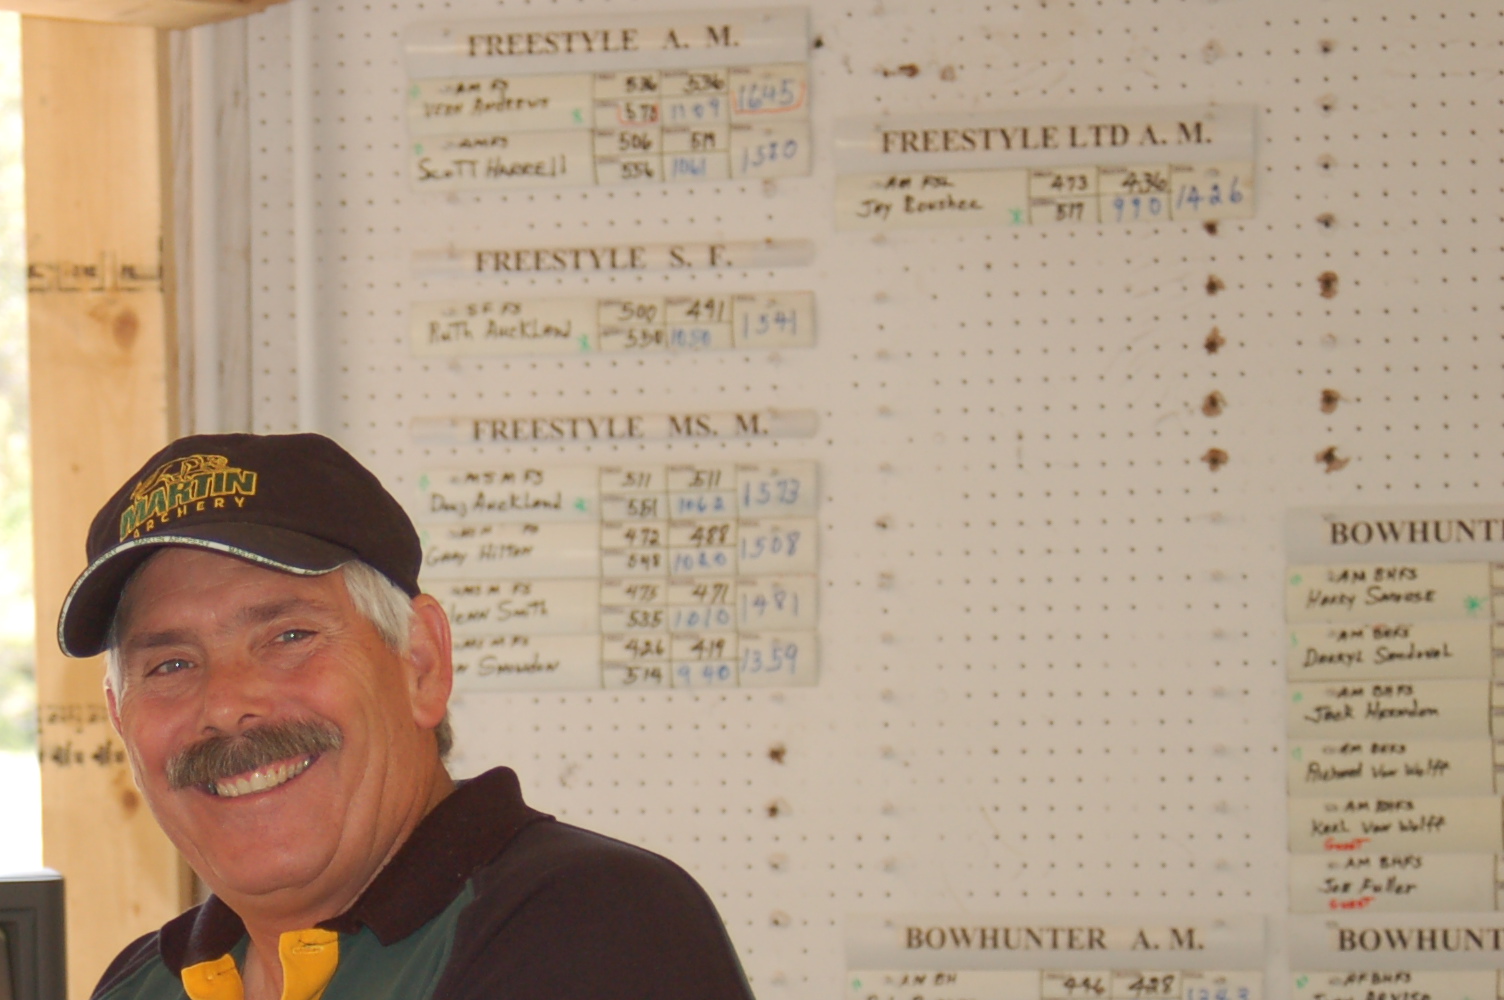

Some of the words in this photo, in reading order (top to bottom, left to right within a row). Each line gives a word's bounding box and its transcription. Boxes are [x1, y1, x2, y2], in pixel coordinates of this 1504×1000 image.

[467, 29, 639, 57] FREESTYLE
[663, 27, 690, 50] A.
[707, 24, 740, 48] M.
[739, 78, 797, 112] 1645
[882, 125, 1059, 154] FREESTYLE
[1070, 123, 1130, 149] LTD
[1139, 124, 1167, 147] A.
[1177, 120, 1212, 145] M.
[1113, 195, 1162, 222] 990
[1177, 175, 1244, 212] 1426
[475, 246, 648, 272] FREESTYLE
[670, 243, 693, 268] S.
[709, 241, 733, 267] F.
[472, 416, 645, 441] FREESTYLE
[668, 413, 719, 438] MS.
[736, 412, 769, 436] M.
[119, 468, 258, 543] MARTIN
[132, 496, 247, 540] ARCHERY
[690, 522, 731, 548] 488
[740, 642, 799, 676] 1359
[905, 926, 1108, 951] BOWHUNTER
[1130, 926, 1159, 950] A.
[1170, 925, 1205, 951] M.
